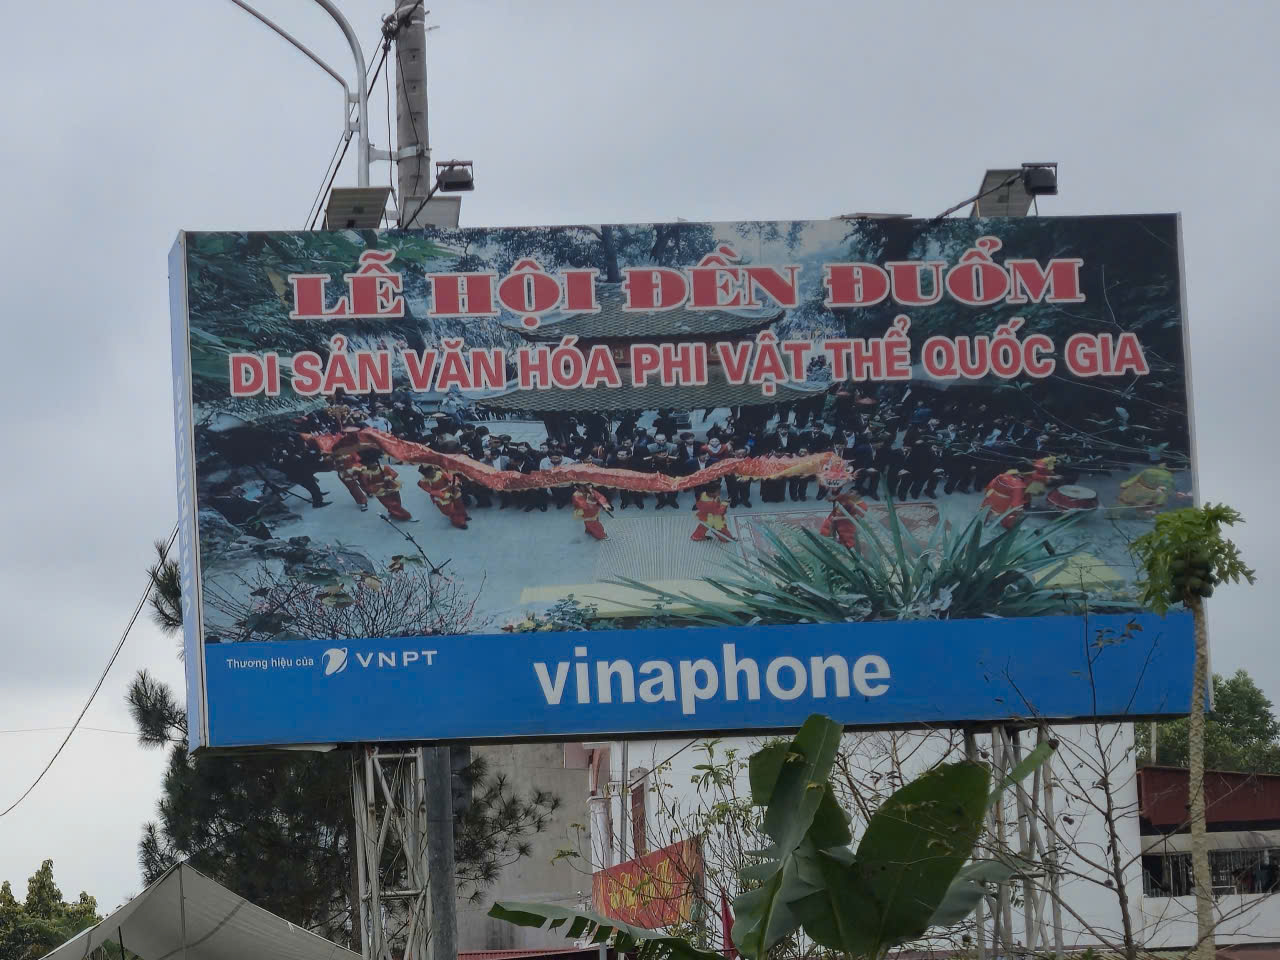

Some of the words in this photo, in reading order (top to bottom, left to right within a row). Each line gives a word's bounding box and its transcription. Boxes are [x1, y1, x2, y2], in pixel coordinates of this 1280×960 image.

[288, 249, 404, 320] LỄ
[426, 260, 601, 329] HỘI
[622, 246, 802, 312] ĐỀN
[823, 235, 1085, 307] ĐUỔM
[229, 352, 280, 398] DI
[291, 333, 393, 396] SẢN
[402, 337, 507, 394] VĂN
[518, 334, 621, 389] HÓA
[631, 341, 708, 387] PHI
[718, 329, 812, 396] VẬT
[824, 314, 912, 382] THỂ
[922, 317, 1055, 380] QUỐC
[1063, 330, 1149, 377] GIA
[226, 658, 268, 670] Thương
[271, 657, 293, 670] hiệu
[295, 656, 314, 668] của
[356, 650, 438, 668] VNPT
[533, 643, 892, 715] vinaphone
